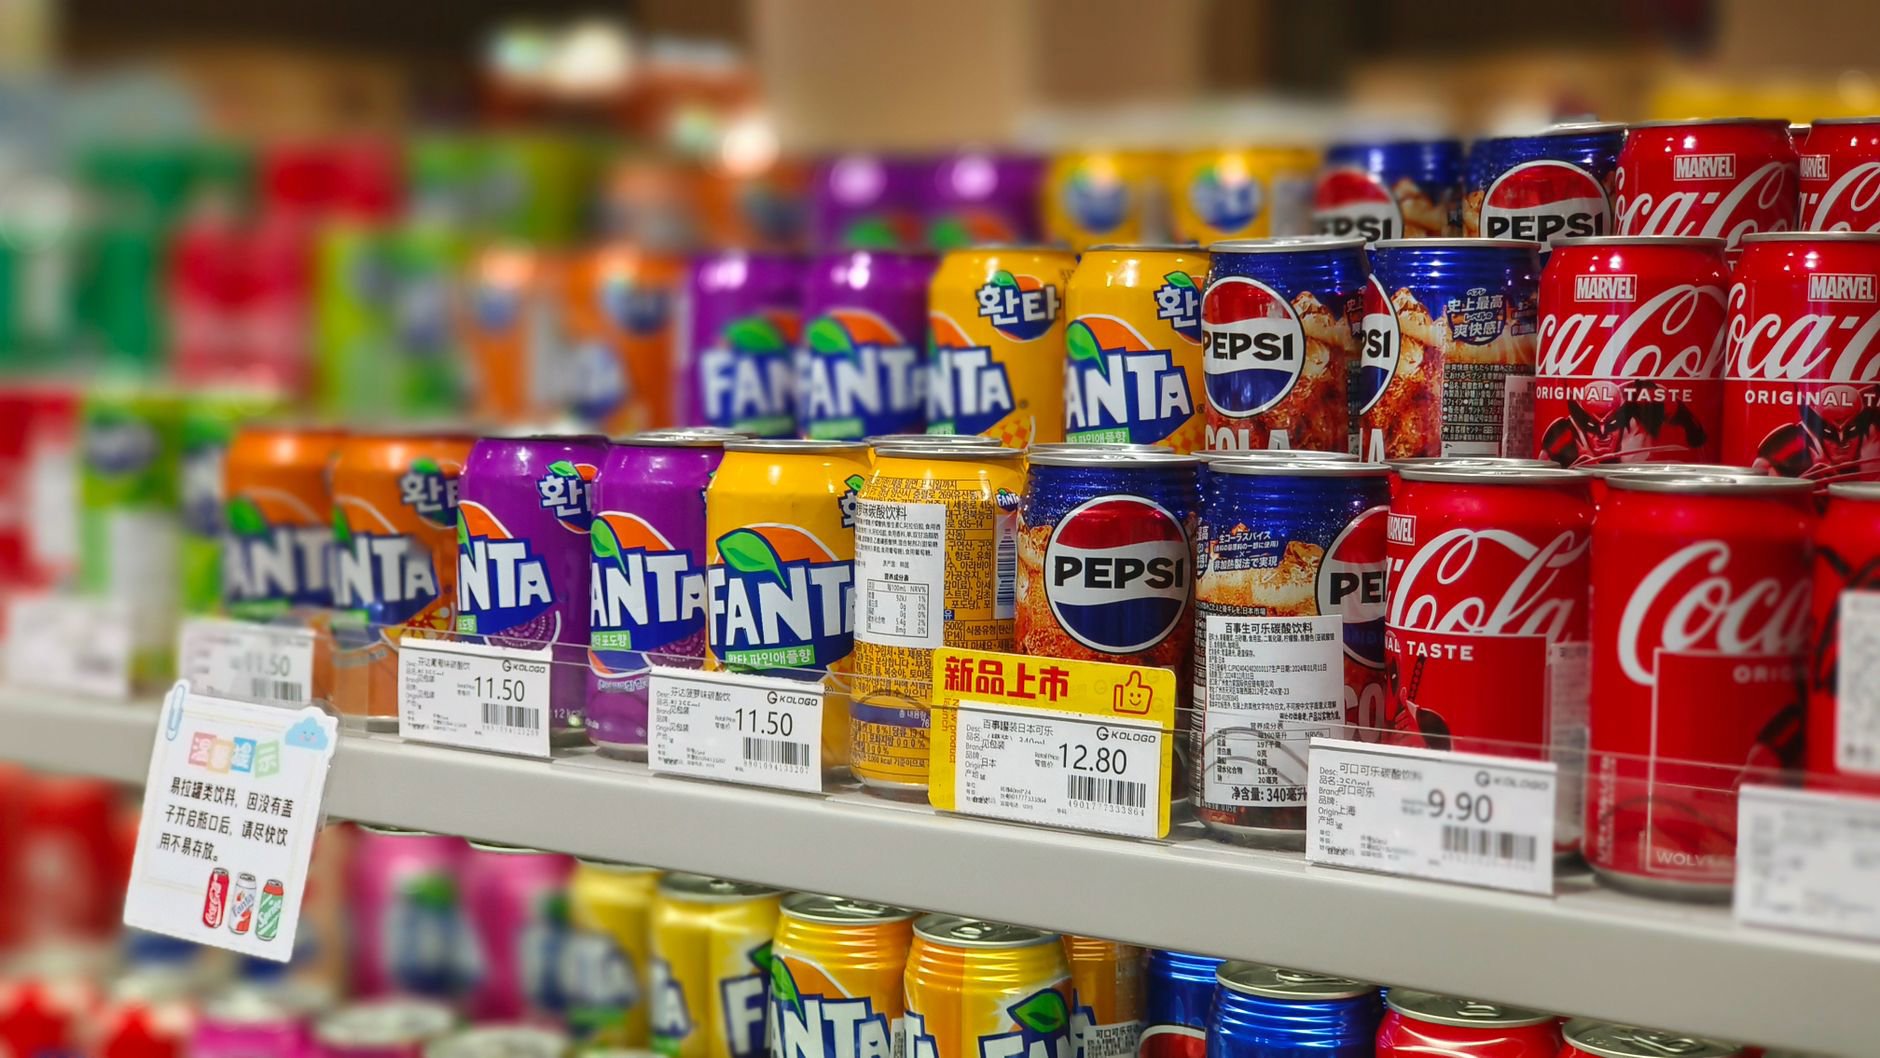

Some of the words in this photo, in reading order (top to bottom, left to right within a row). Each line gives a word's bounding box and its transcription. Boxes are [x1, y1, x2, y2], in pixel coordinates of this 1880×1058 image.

[1675, 157, 1734, 180] MARVEL
[1487, 216, 1603, 244] PEPSI
[1576, 277, 1635, 300] MARVEL
[1811, 276, 1868, 300] MARVEL
[981, 284, 1060, 326] 환타
[1446, 294, 1504, 313] 史上最高
[1203, 333, 1294, 361] PEPSI
[1537, 388, 1613, 403] ORIGINAL
[1624, 387, 1692, 403] TASTE
[1745, 389, 1852, 407] ORIGINAL
[1054, 556, 1184, 589] PEPSI
[1330, 571, 1388, 606] PE
[1225, 622, 1314, 635] 百事生可乐碳酸饮料
[1407, 645, 1474, 666] TASTE
[474, 676, 525, 703] 11.50
[944, 655, 1069, 704] 新品上市
[779, 696, 818, 708] KOLOGO
[736, 708, 793, 737] 11.50
[1112, 729, 1157, 744] KOLOGO
[1059, 743, 1127, 775] 12.80
[1337, 785, 1375, 798] 可口可乐
[1428, 788, 1493, 824] 9.90
